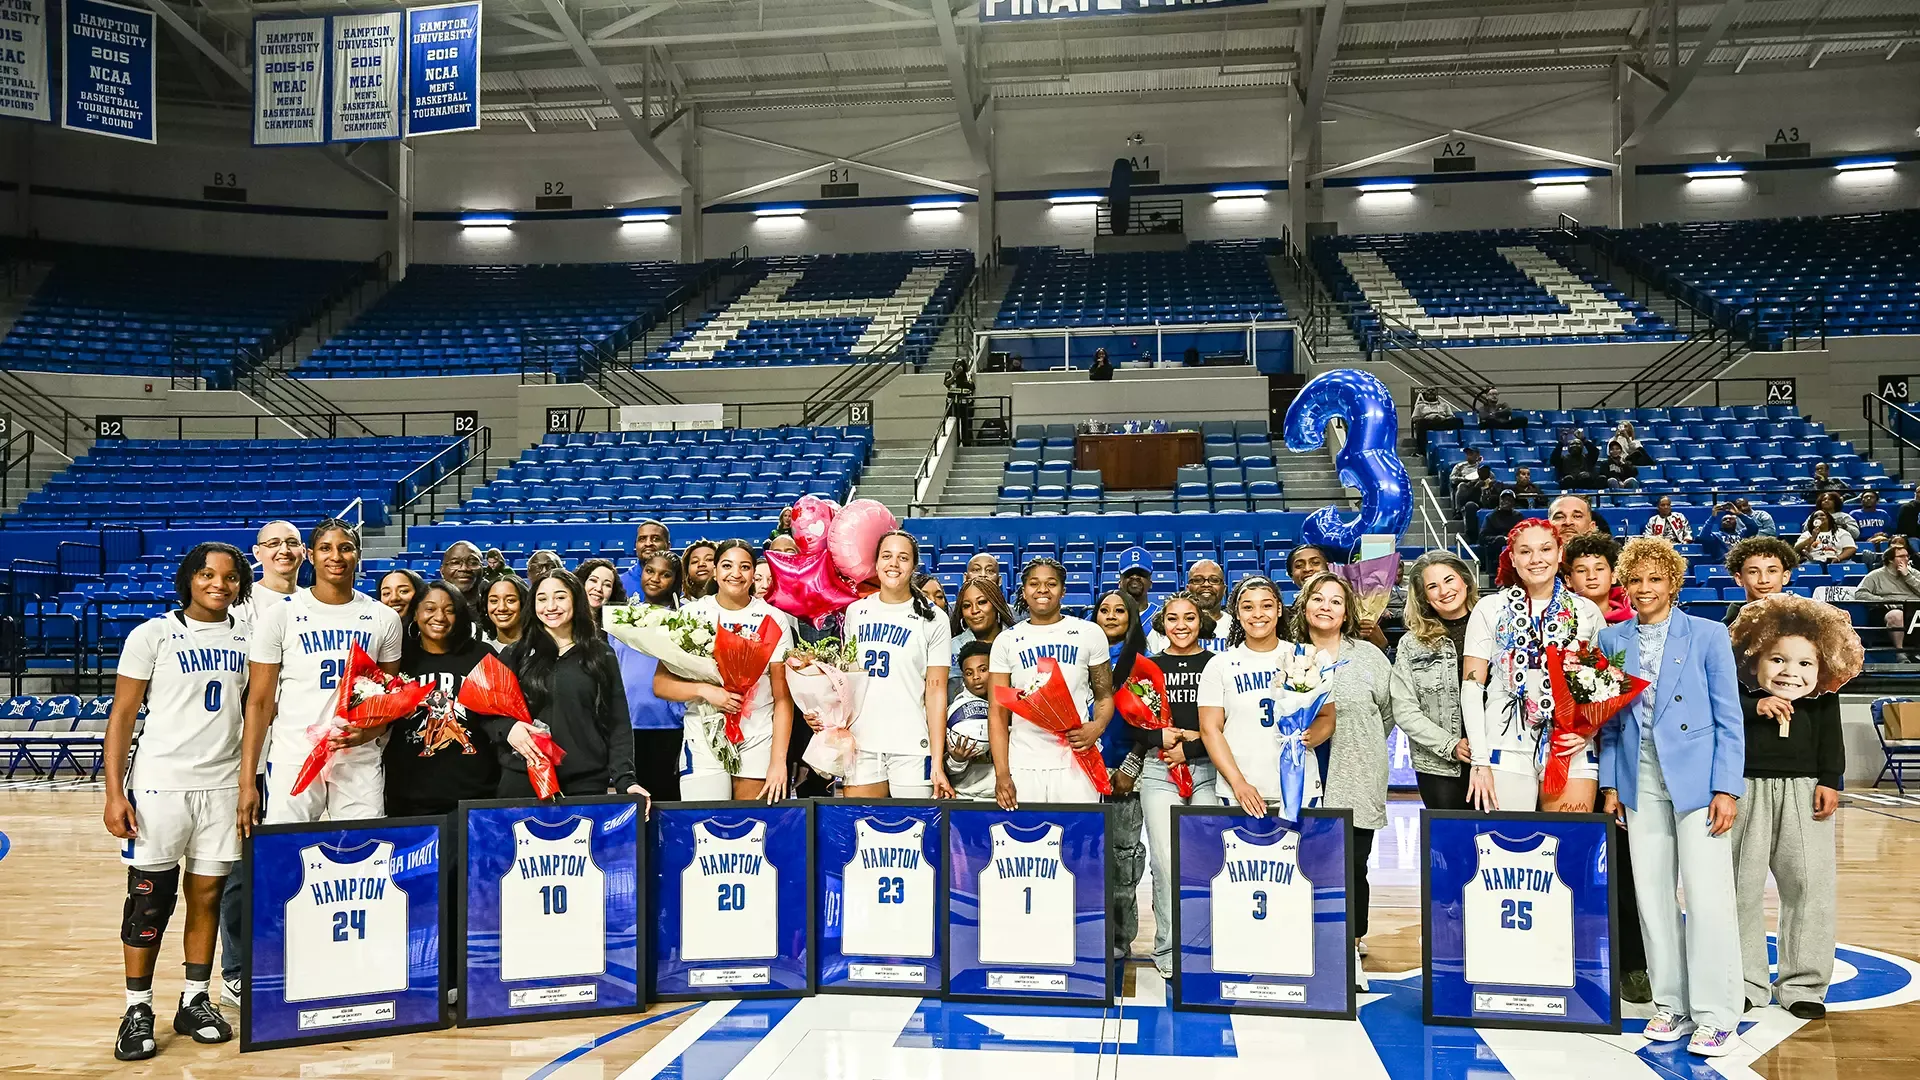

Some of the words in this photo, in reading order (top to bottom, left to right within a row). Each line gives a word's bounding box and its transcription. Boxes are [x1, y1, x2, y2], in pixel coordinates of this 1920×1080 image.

[79, 13, 139, 34] HAMPTON
[419, 18, 468, 33] HAMPTON
[72, 24, 147, 48] UNIVERSITY
[266, 32, 314, 43] HAMPTON
[343, 26, 390, 39] HAMPTON
[413, 28, 474, 45] UNIVERSITY
[260, 43, 320, 55] UNIVERSITY
[337, 36, 396, 50] UNIVERSITY
[91, 46, 130, 64] 2015
[351, 56, 381, 68] 2016
[426, 47, 458, 62] 2016
[89, 65, 132, 85] NCAA
[265, 61, 314, 74] 2015-16
[425, 65, 459, 82] NCAA
[96, 83, 125, 96] MEN'S
[273, 80, 307, 94] MEAC
[349, 75, 382, 89] MEAC
[429, 82, 455, 93] MEN'S
[80, 91, 139, 109] BASKETBALL
[276, 96, 302, 106] MEN'S
[355, 90, 377, 100] MEN'S
[416, 92, 468, 107] BASKETBALL
[76, 101, 143, 120] TOURNAMENT
[263, 107, 315, 119] BASKETBALL
[342, 100, 388, 111] BASKETBALL
[413, 104, 472, 119] TOURNAMENT
[102, 117, 134, 129] ROUND
[264, 119, 313, 130] CHAMPIONS
[340, 110, 392, 123] TOURNAMENT
[344, 121, 387, 132] CHAMPIONS
[1767, 384, 1793, 400] A2
[1882, 381, 1908, 398] A3
[551, 414, 567, 428] B1
[852, 407, 868, 421] B1
[100, 421, 121, 437] B2
[456, 416, 474, 432] B2
[1131, 551, 1140, 562] B
[299, 629, 372, 654] HAMPTON
[858, 622, 912, 648] HAMPTON
[176, 648, 246, 675] HAMPTON
[864, 650, 890, 678] 23
[1018, 644, 1079, 669] HAMPTON
[204, 681, 222, 712] 0
[1259, 698, 1275, 727] 3
[518, 854, 587, 880] HAMPTON
[698, 853, 763, 876] HAMPTON
[860, 847, 921, 870] HAMPTON
[995, 856, 1059, 880] HAMPTON
[1227, 860, 1295, 885] HAMPTON
[1480, 867, 1553, 894] HAMPTON
[310, 877, 387, 905] HAMPTON
[717, 883, 745, 911] 20
[878, 876, 905, 904] 23
[539, 885, 568, 915] 10
[1023, 887, 1031, 914] 1
[1252, 890, 1267, 920] 3
[1500, 899, 1533, 930] 25
[332, 909, 366, 942] 24
